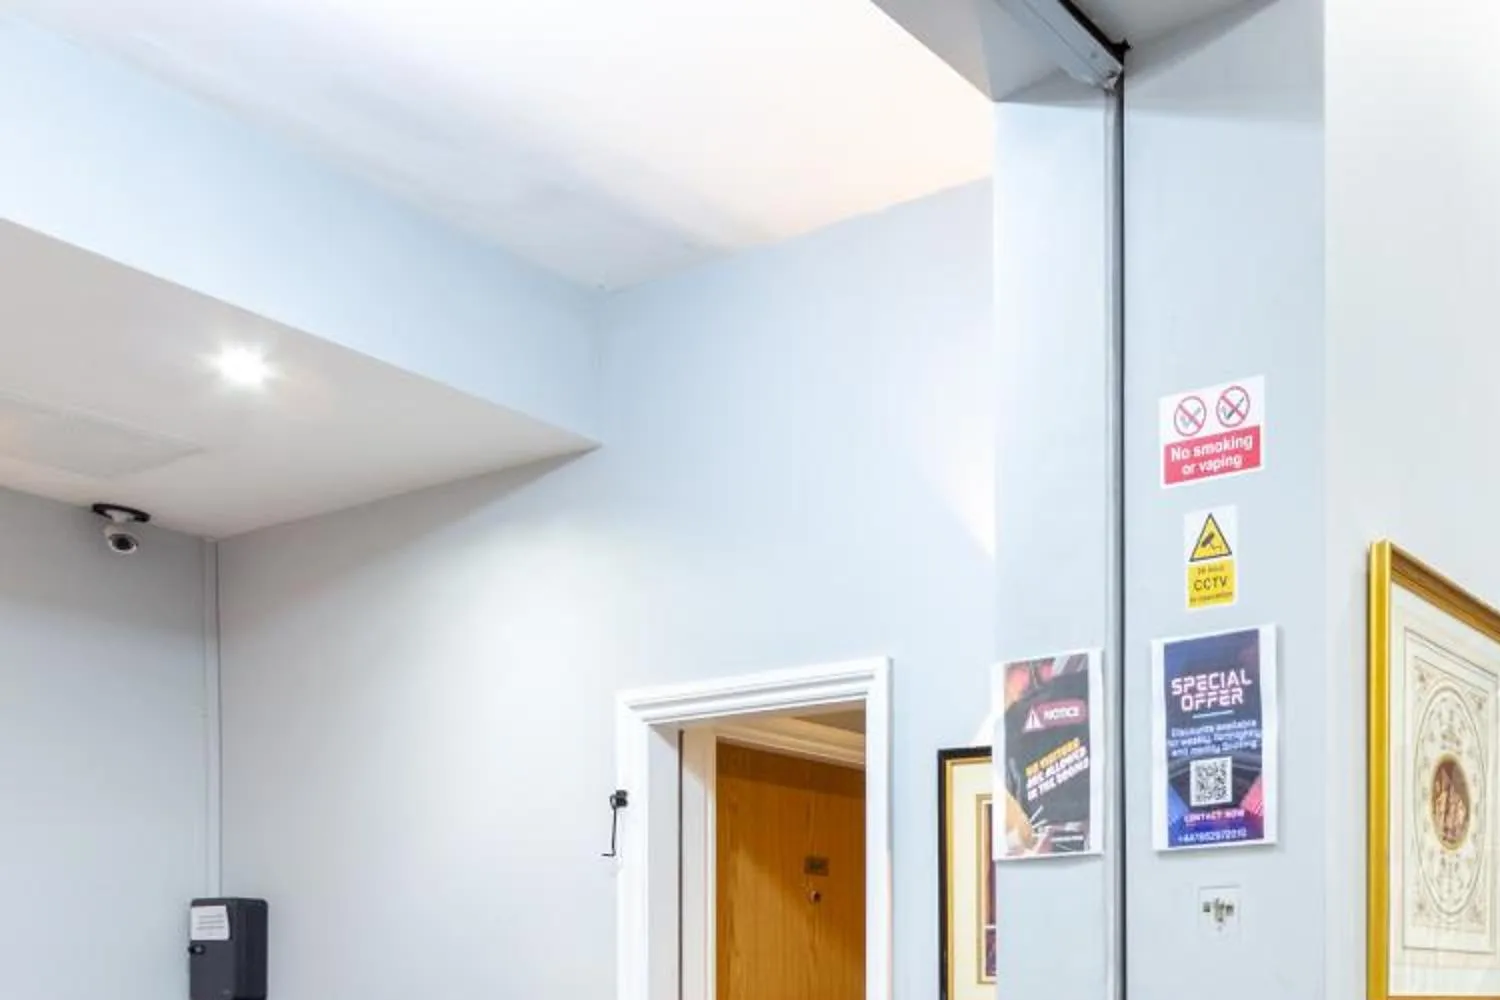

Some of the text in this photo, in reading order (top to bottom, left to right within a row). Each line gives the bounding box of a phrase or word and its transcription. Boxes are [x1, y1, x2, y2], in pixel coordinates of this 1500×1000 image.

[1171, 435, 1253, 462] No smoking
[1182, 453, 1243, 475] or vaping
[1193, 576, 1229, 592] CCTV
[1171, 668, 1252, 696] SPECIAL
[1181, 687, 1244, 712] OFFER
[1183, 807, 1245, 822] CONTACT NOW
